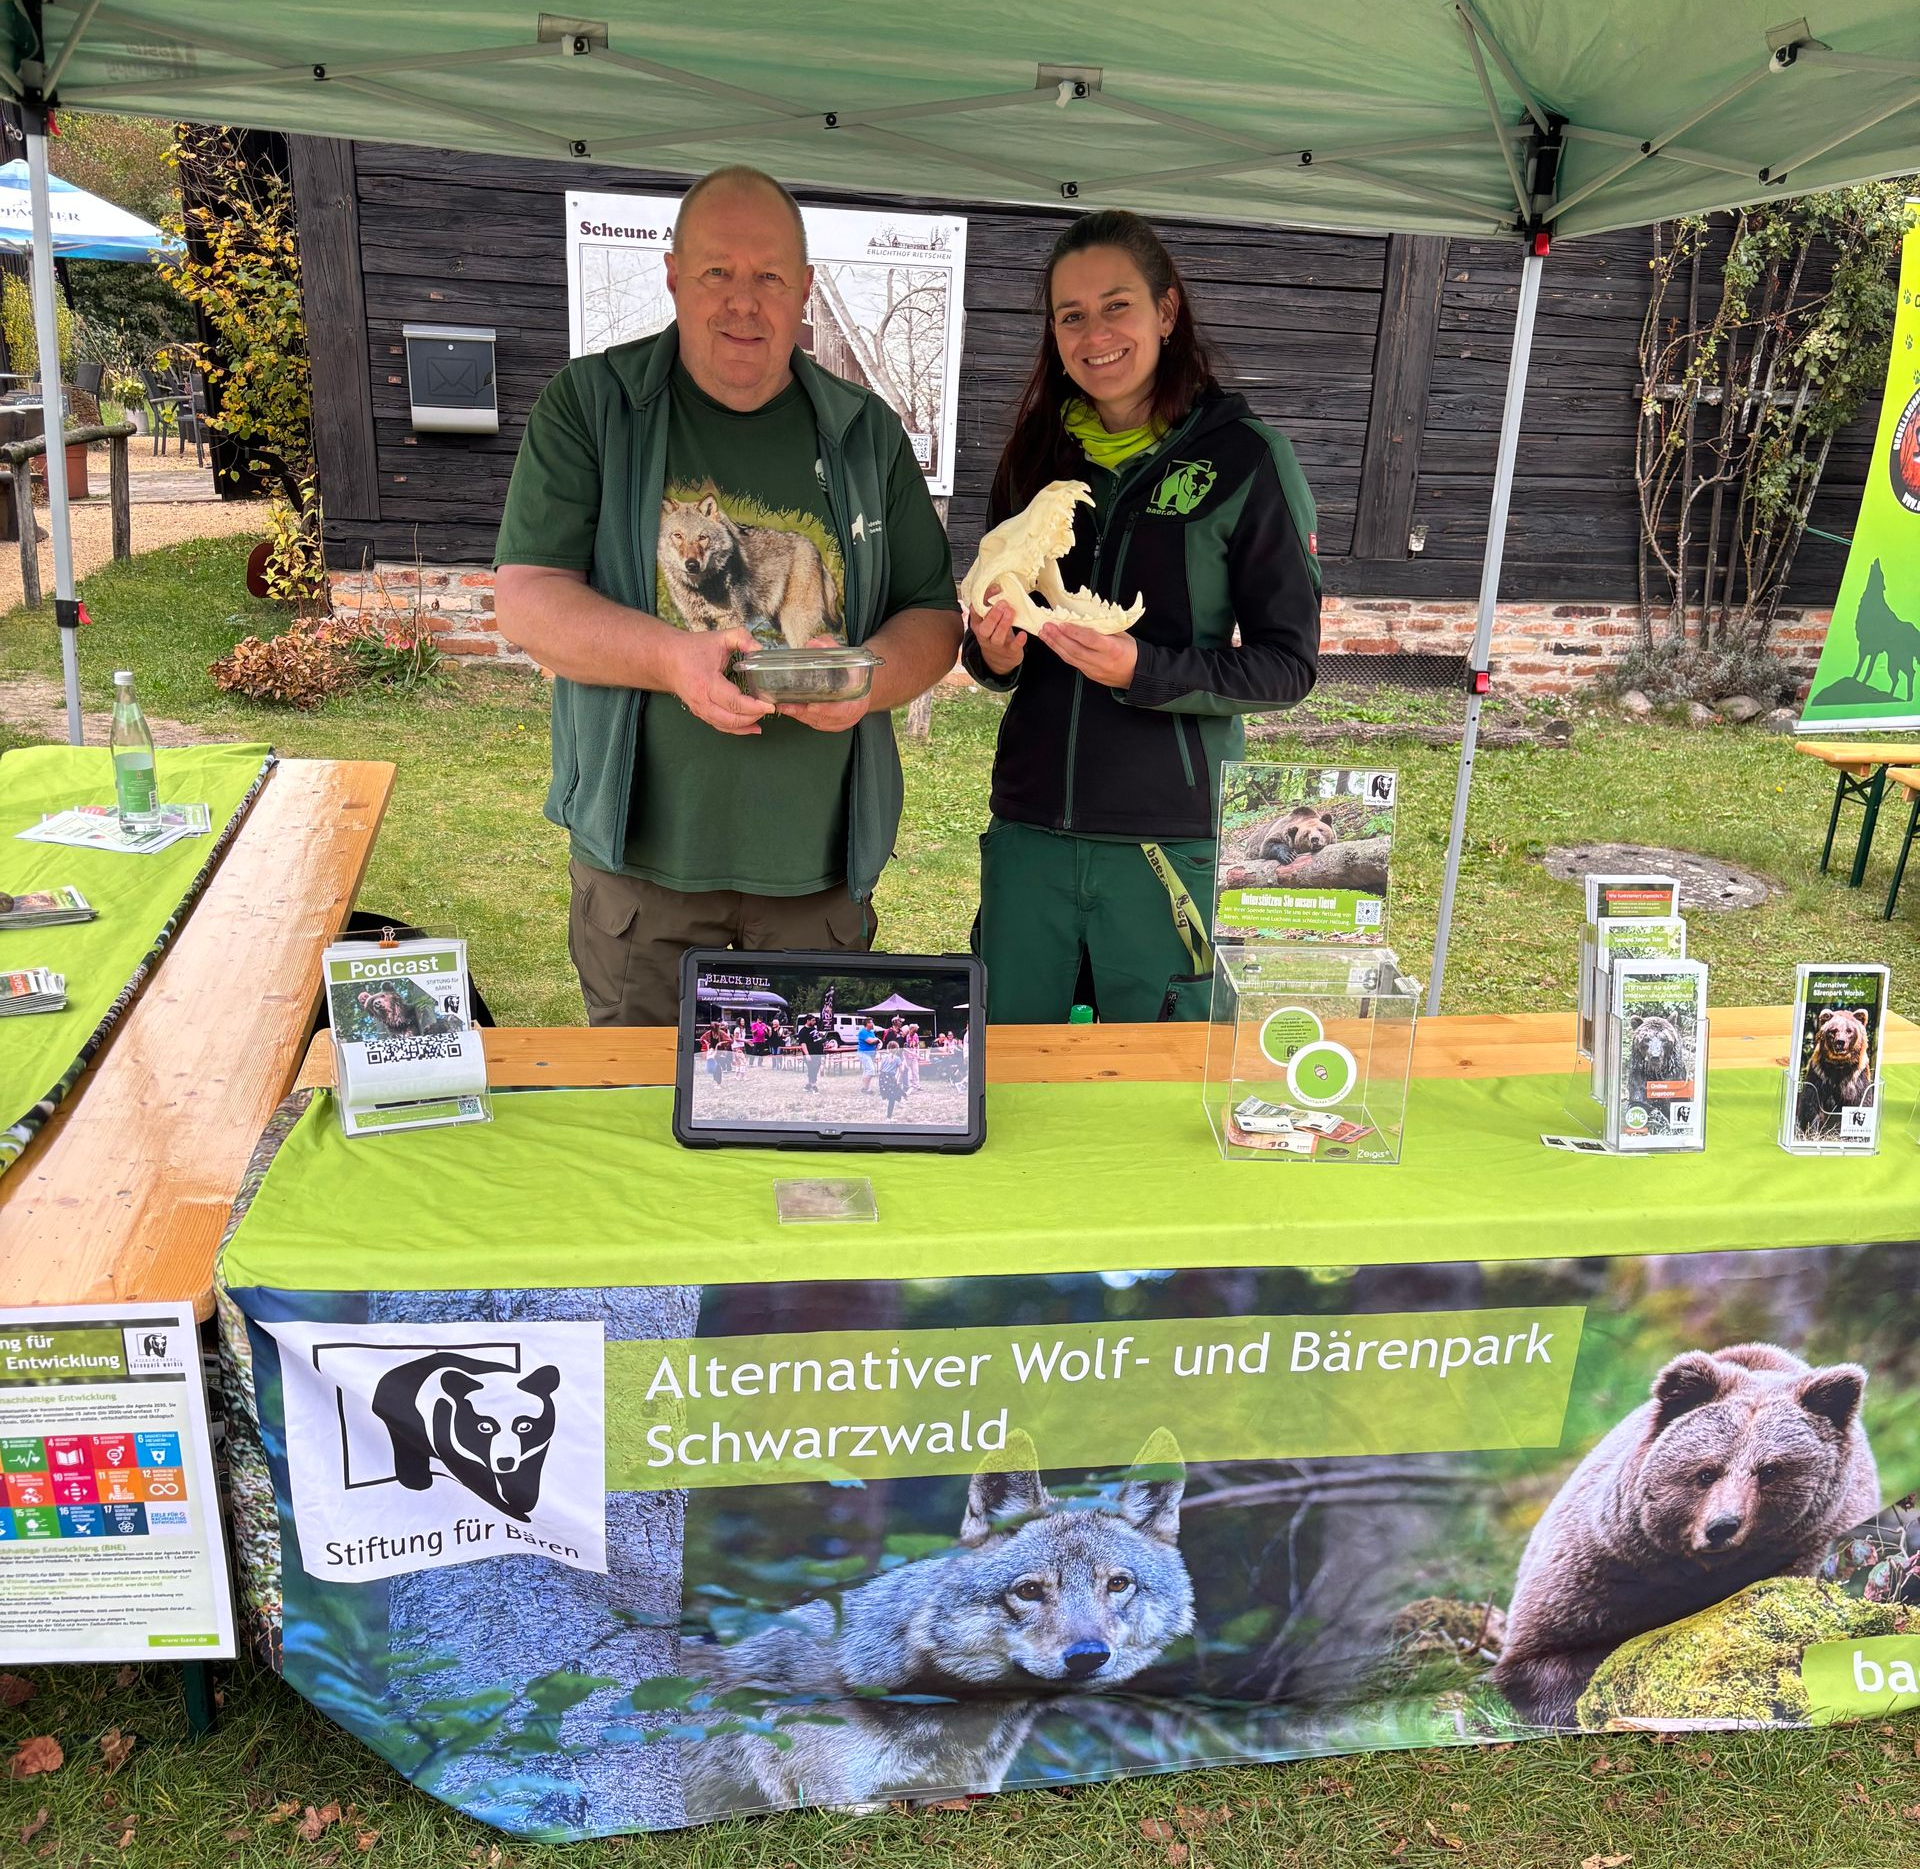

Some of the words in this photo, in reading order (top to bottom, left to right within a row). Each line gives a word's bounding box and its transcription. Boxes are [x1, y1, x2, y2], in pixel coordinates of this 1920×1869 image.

[580, 221, 657, 240] Scheune
[1283, 894, 1294, 908] Sie
[350, 956, 439, 979] Podcast
[705, 973, 743, 986] BLACK
[745, 976, 770, 987] BULL
[1813, 989, 1843, 997] Bärenpark
[26, 1335, 54, 1349] für
[6, 1354, 120, 1369] Entwicklung
[645, 1347, 992, 1400] Alternativer
[1011, 1336, 1149, 1385] Wolf-
[1173, 1331, 1270, 1377] und
[1290, 1323, 1553, 1378] Bärenpark
[58, 1392, 117, 1402] Entwicklung
[2, 1440, 9, 1449] 3
[48, 1438, 55, 1447] 4
[93, 1436, 100, 1446] 5
[137, 1434, 144, 1444] 6
[646, 1408, 1008, 1467] Schwarzwald
[53, 1472, 64, 1482] 10
[98, 1471, 106, 1480] 11
[142, 1469, 152, 1478] 12
[15, 1508, 25, 1517] 15
[59, 1506, 70, 1515] 16
[103, 1504, 112, 1514] 17
[326, 1530, 442, 1566] Stiftung
[453, 1519, 496, 1545] für
[505, 1522, 579, 1559] Bären
